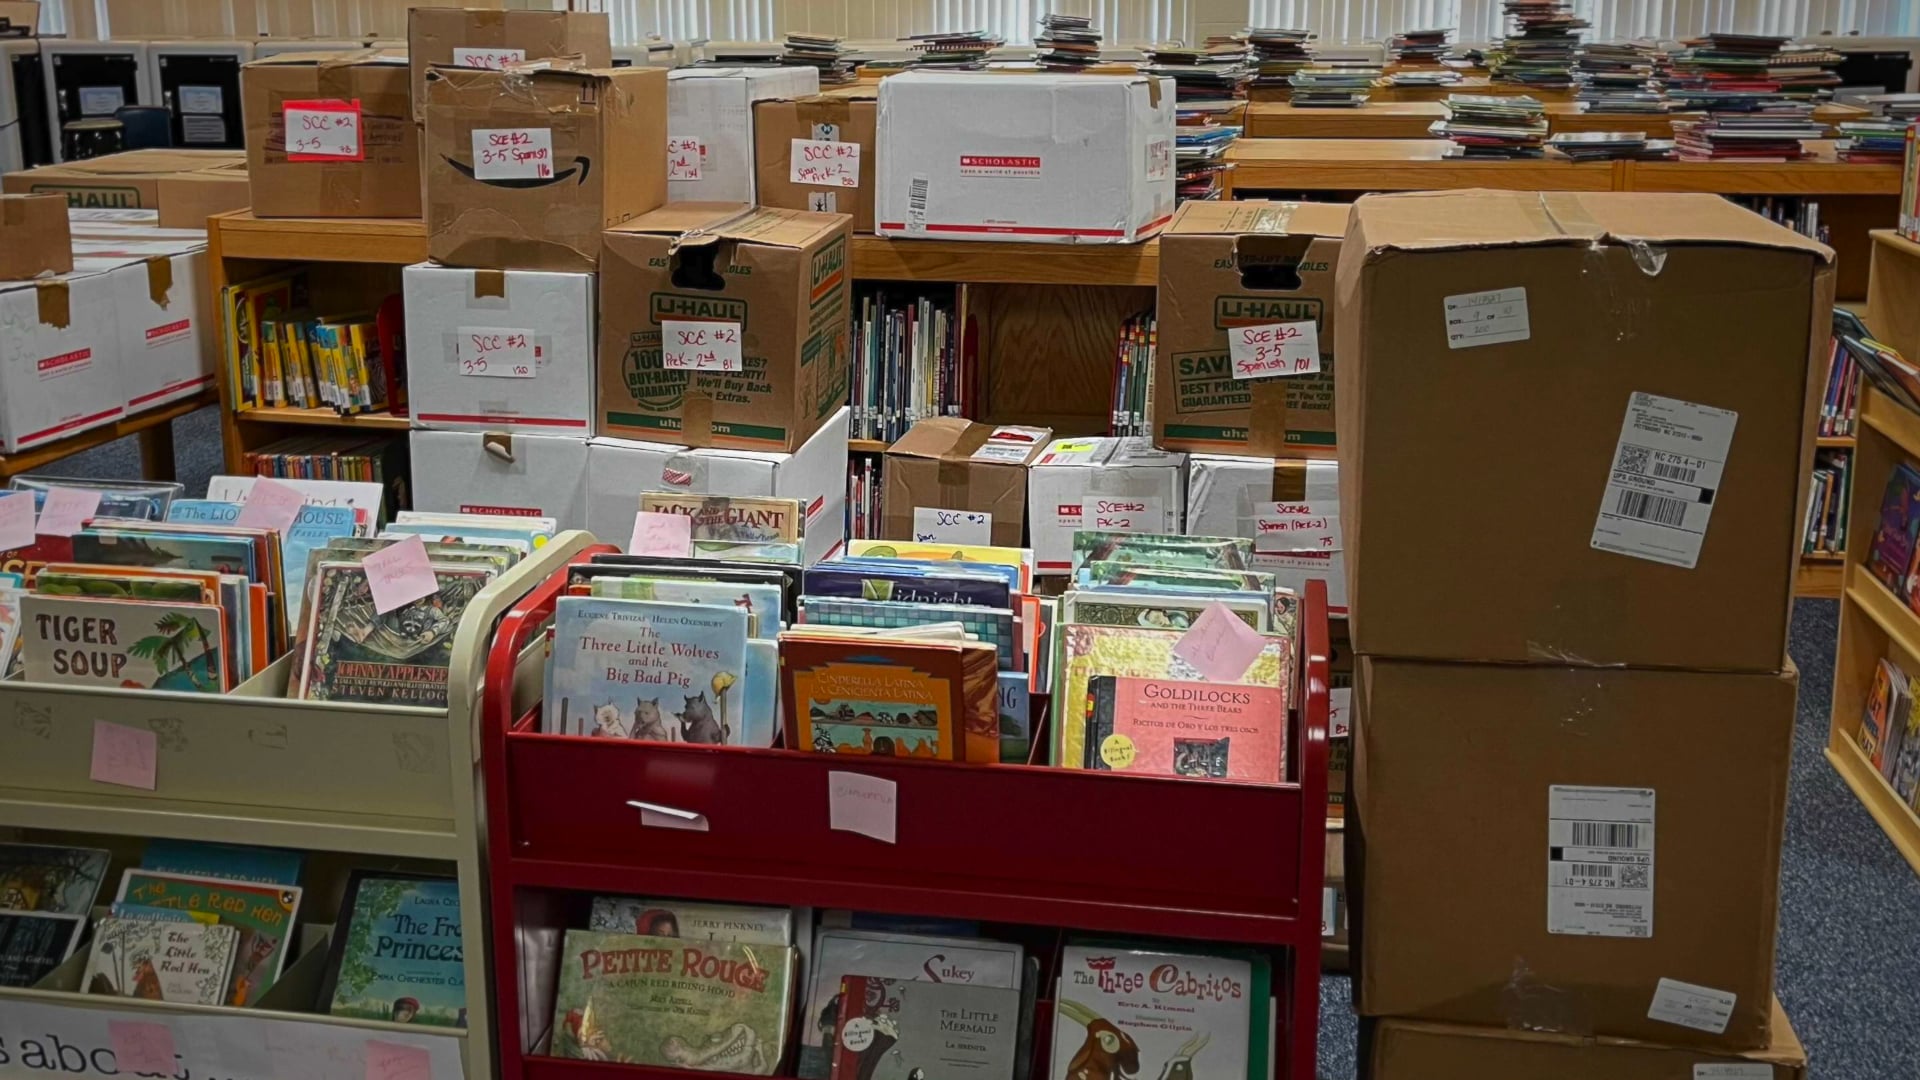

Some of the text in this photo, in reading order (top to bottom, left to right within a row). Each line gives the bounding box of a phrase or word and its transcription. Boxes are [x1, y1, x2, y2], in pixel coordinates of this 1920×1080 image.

[302, 115, 353, 131] SCE #2
[296, 137, 321, 151] 3-5
[482, 148, 548, 166] 3-5 Spanish
[803, 145, 858, 162] SCE #2
[971, 157, 1039, 166] SCHOLASTIC
[68, 192, 134, 208] HAUL
[656, 298, 742, 319] U-HAUL
[1221, 301, 1316, 319] U-HAUL
[471, 334, 527, 353] SCE #2
[678, 329, 737, 346] SCE #2
[1243, 330, 1271, 345] SCE
[630, 350, 663, 370] 100
[1255, 343, 1285, 361] 3-5
[463, 357, 488, 374] 3-5
[1179, 355, 1231, 376] SAV
[1236, 359, 1286, 376] Spanish
[697, 377, 773, 394] We'll Buy Back
[1180, 379, 1250, 395] BEST PRICE
[716, 391, 751, 404] Extras.
[1181, 394, 1252, 408] GUARANTEED
[1654, 451, 1666, 462] NC
[1667, 454, 1682, 465] 275
[1628, 475, 1656, 486] GROUND
[185, 507, 206, 520] The
[210, 508, 241, 521] LIO
[471, 507, 540, 517] SCHOLASTIC
[723, 507, 784, 530] GIANT
[936, 511, 961, 526] SCE
[577, 609, 609, 620] EUGENE
[652, 614, 679, 625] HELEN
[680, 617, 724, 628] OXENBURY
[35, 613, 118, 646] TIGER
[639, 626, 661, 638] The
[579, 636, 720, 660] Three Little Wolves
[53, 648, 128, 678] SOUP
[337, 661, 449, 682] JOHNNY APPLESEE
[628, 657, 669, 669] and the
[606, 667, 692, 688] Big Bad Pig
[817, 672, 925, 689] CINDERELLA LATINA
[331, 686, 450, 700] STEVEN KELLOG
[810, 685, 823, 696] LA
[893, 687, 934, 700] LATINA
[1143, 683, 1251, 705] GOLDILOCKS
[1187, 703, 1215, 713] THREE
[1217, 705, 1242, 714] BEARS
[1133, 718, 1164, 728] RICITOS
[1165, 721, 1176, 729] DE
[1177, 721, 1196, 730] ORO
[387, 913, 463, 937] The Fro
[691, 919, 766, 933] JERRY PINKNEY
[168, 931, 189, 944] The
[165, 945, 197, 959] Little
[374, 935, 464, 963] Princes
[160, 960, 210, 975] Red Hen
[580, 948, 770, 993] PETITE ROUGE
[923, 954, 975, 983] Sukey
[1073, 956, 1242, 1002] The Three Cabritos
[617, 979, 648, 990] CAJUN
[650, 980, 669, 989] RED
[671, 980, 705, 993] RIDING
[706, 985, 735, 998] HOOD
[940, 1008, 999, 1023] THE LITTLE
[1117, 1001, 1195, 1014] Eric A. Kimmel
[940, 1019, 997, 1036] MERMAID
[1117, 1019, 1193, 1032] Stephen Gilpin
